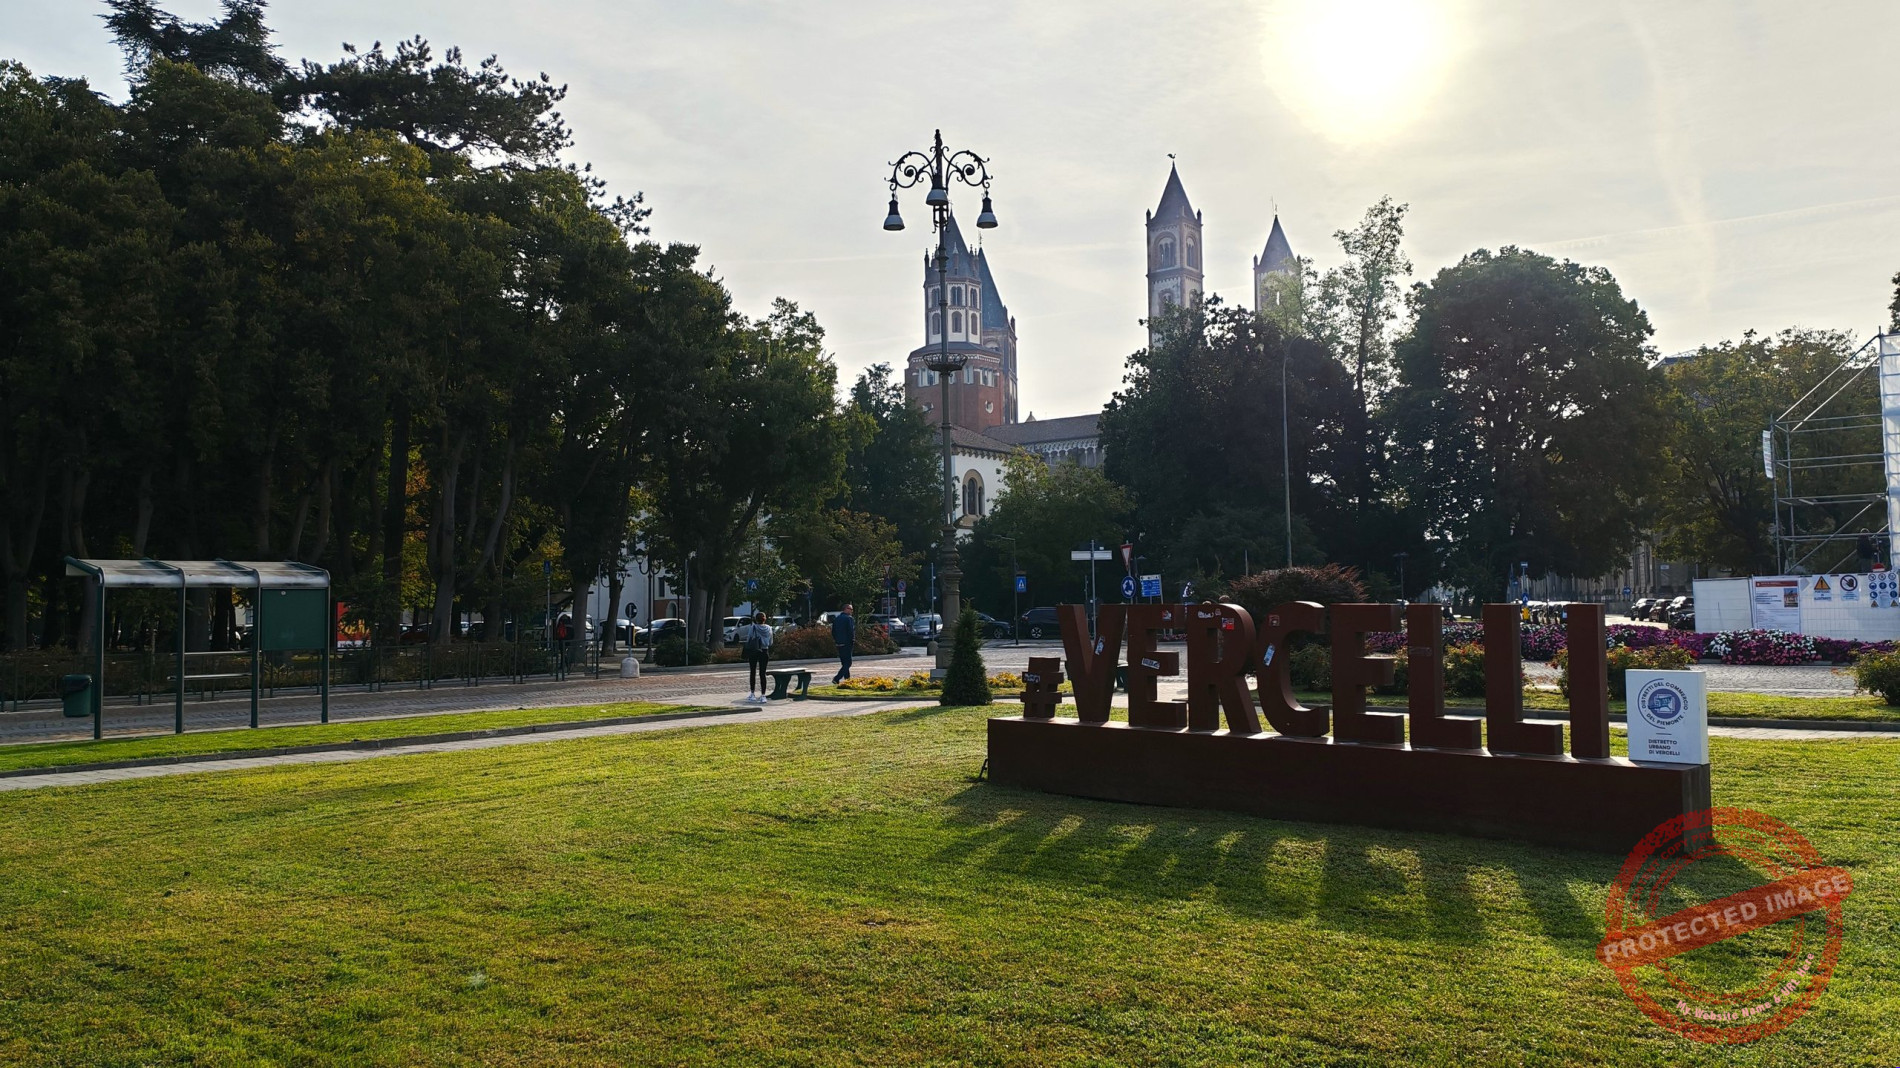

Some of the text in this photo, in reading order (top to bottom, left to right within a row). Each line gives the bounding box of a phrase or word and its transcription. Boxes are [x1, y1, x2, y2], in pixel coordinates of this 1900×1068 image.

[1665, 682, 1688, 711] COMMERCIO
[1646, 712, 1684, 725] DEL PIEMONTE
